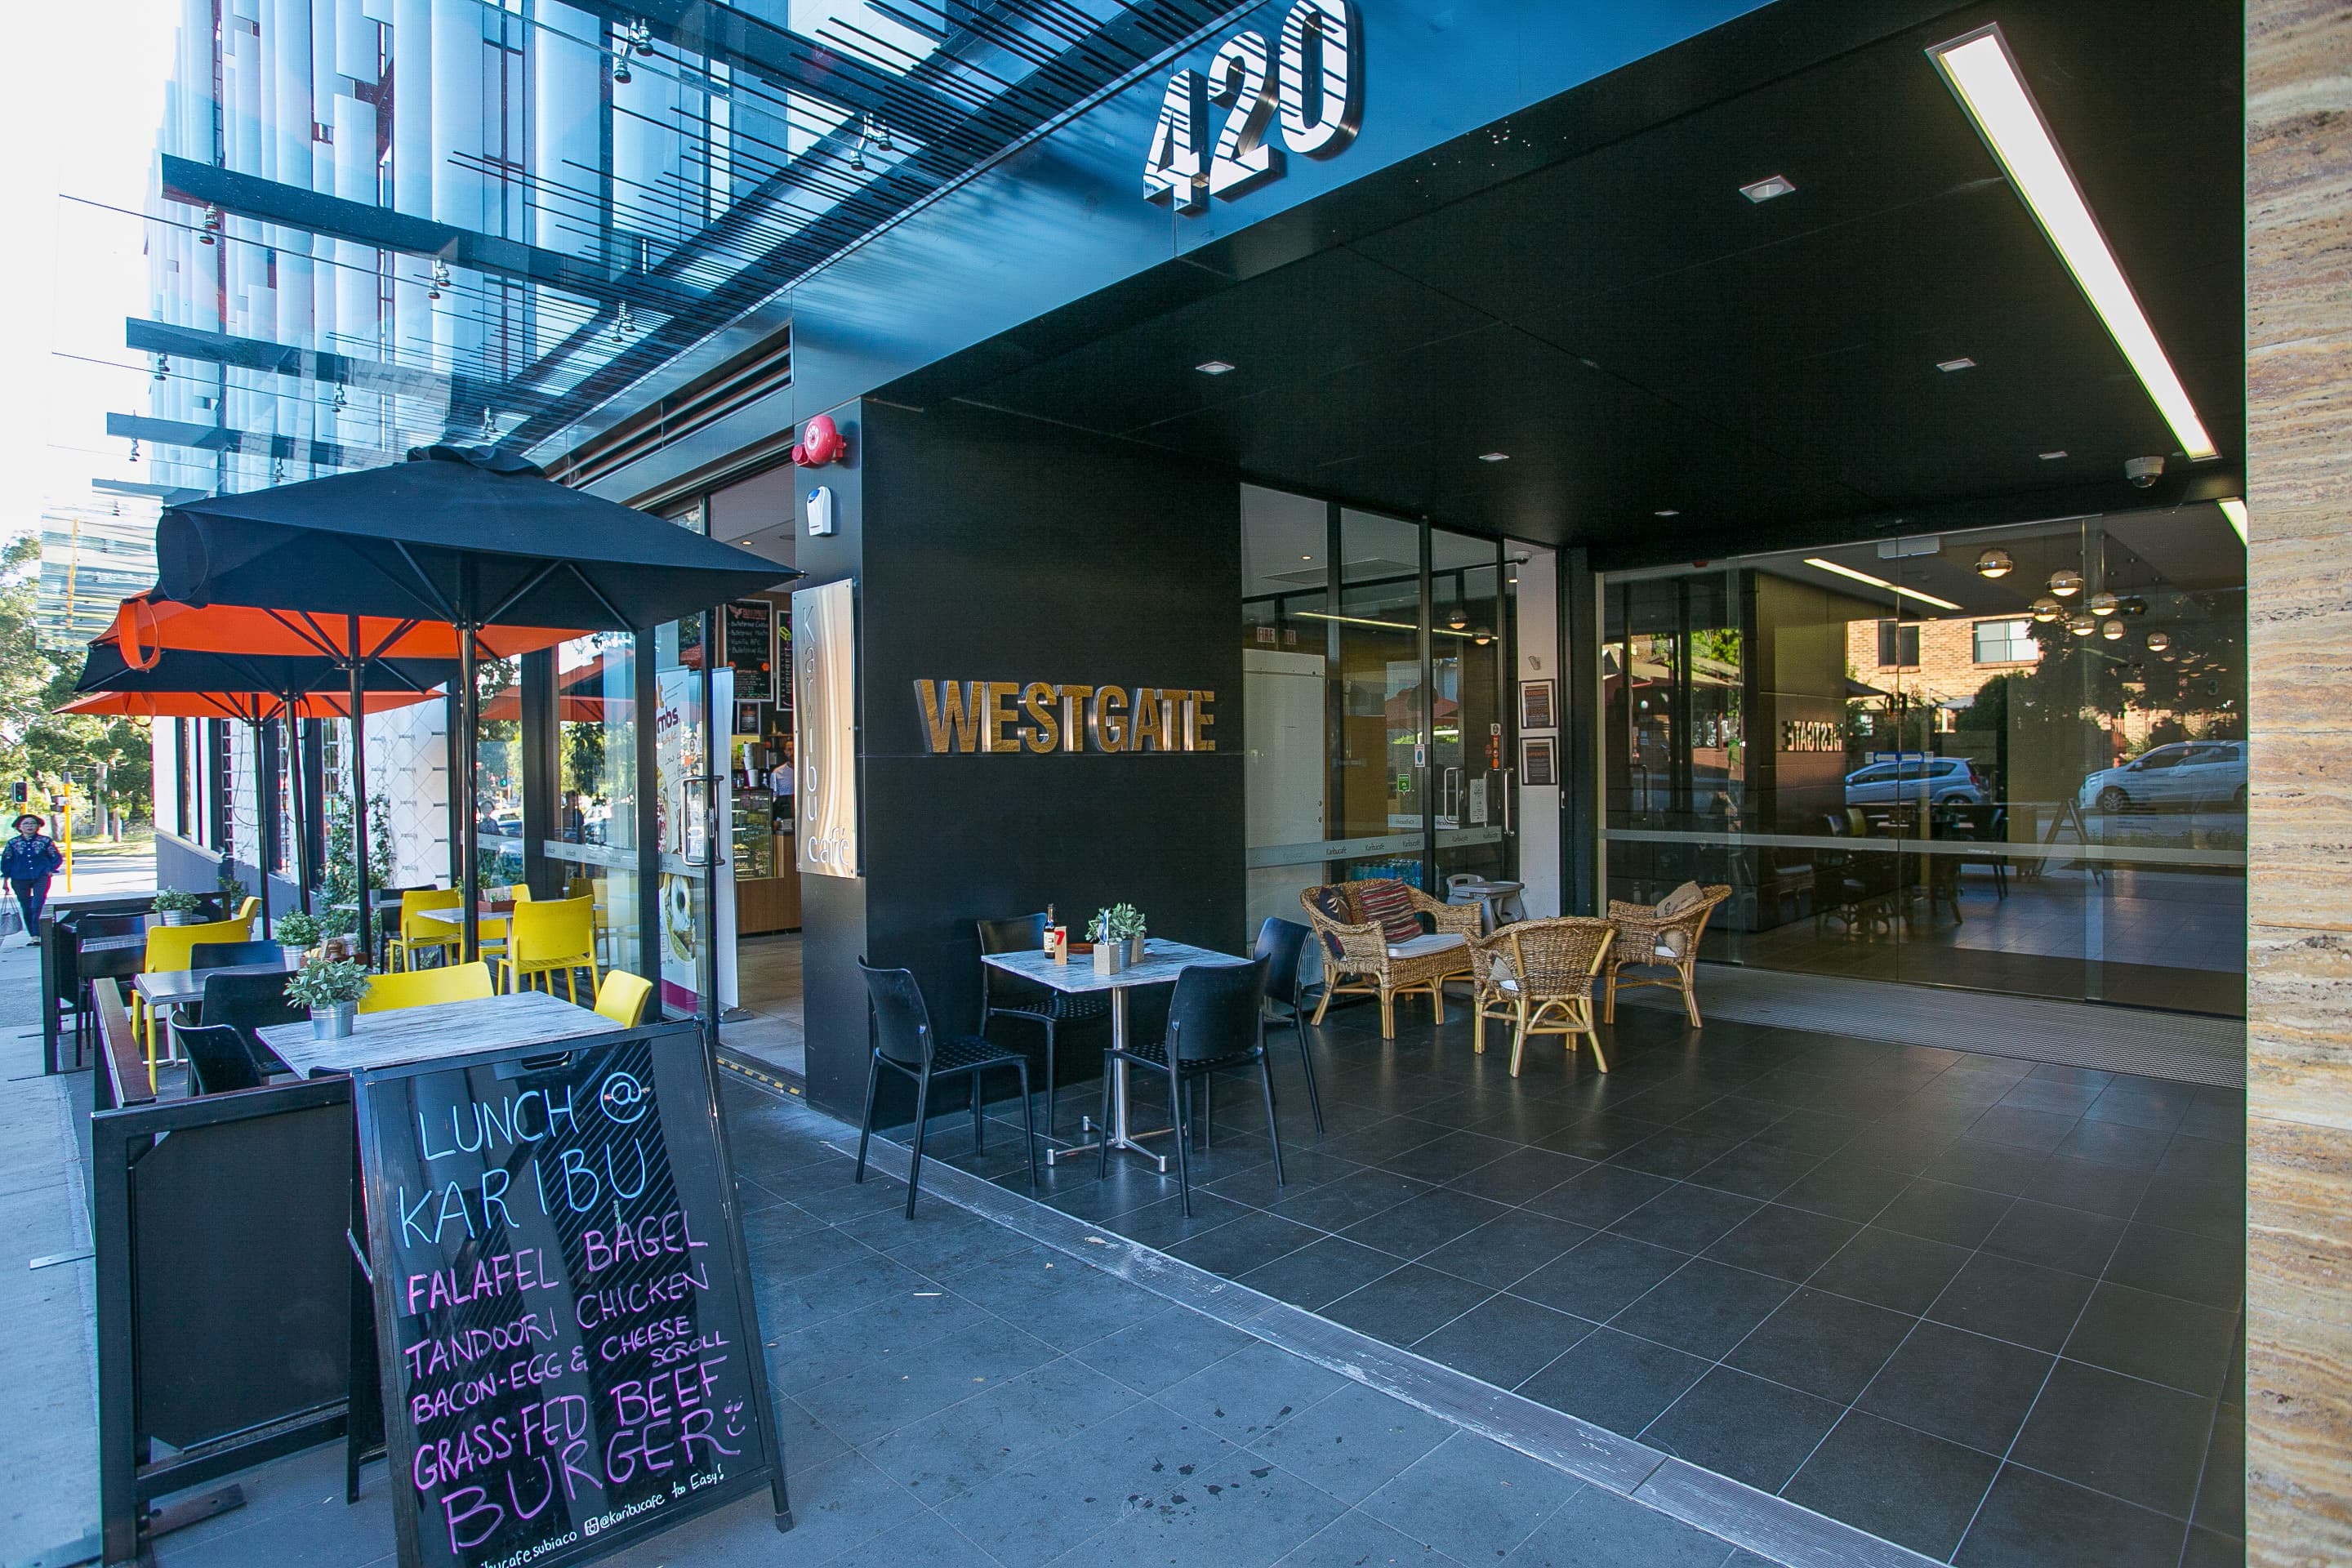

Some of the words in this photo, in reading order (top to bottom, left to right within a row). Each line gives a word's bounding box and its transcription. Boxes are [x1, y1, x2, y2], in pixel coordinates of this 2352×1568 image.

[1143, 0, 1348, 211] 420
[656, 706, 679, 733] mbs
[915, 679, 1216, 754] WESTGATE
[807, 827, 849, 866] café
[1054, 930, 1065, 946] 7
[419, 1085, 579, 1161] LUNCH
[599, 1071, 648, 1123] @
[399, 1138, 647, 1249] KARIBU
[408, 1248, 559, 1315] FALAFEL
[585, 1210, 708, 1272] BAGEL
[405, 1307, 558, 1379] TANDOORI
[576, 1263, 709, 1329] CHICKEN
[570, 1346, 588, 1372] &
[601, 1316, 693, 1361] CHEESE
[650, 1330, 730, 1368] SCROLL
[610, 1355, 727, 1427] BEEF
[442, 1408, 741, 1554] BURGER
[690, 1463, 724, 1490] Easy!
